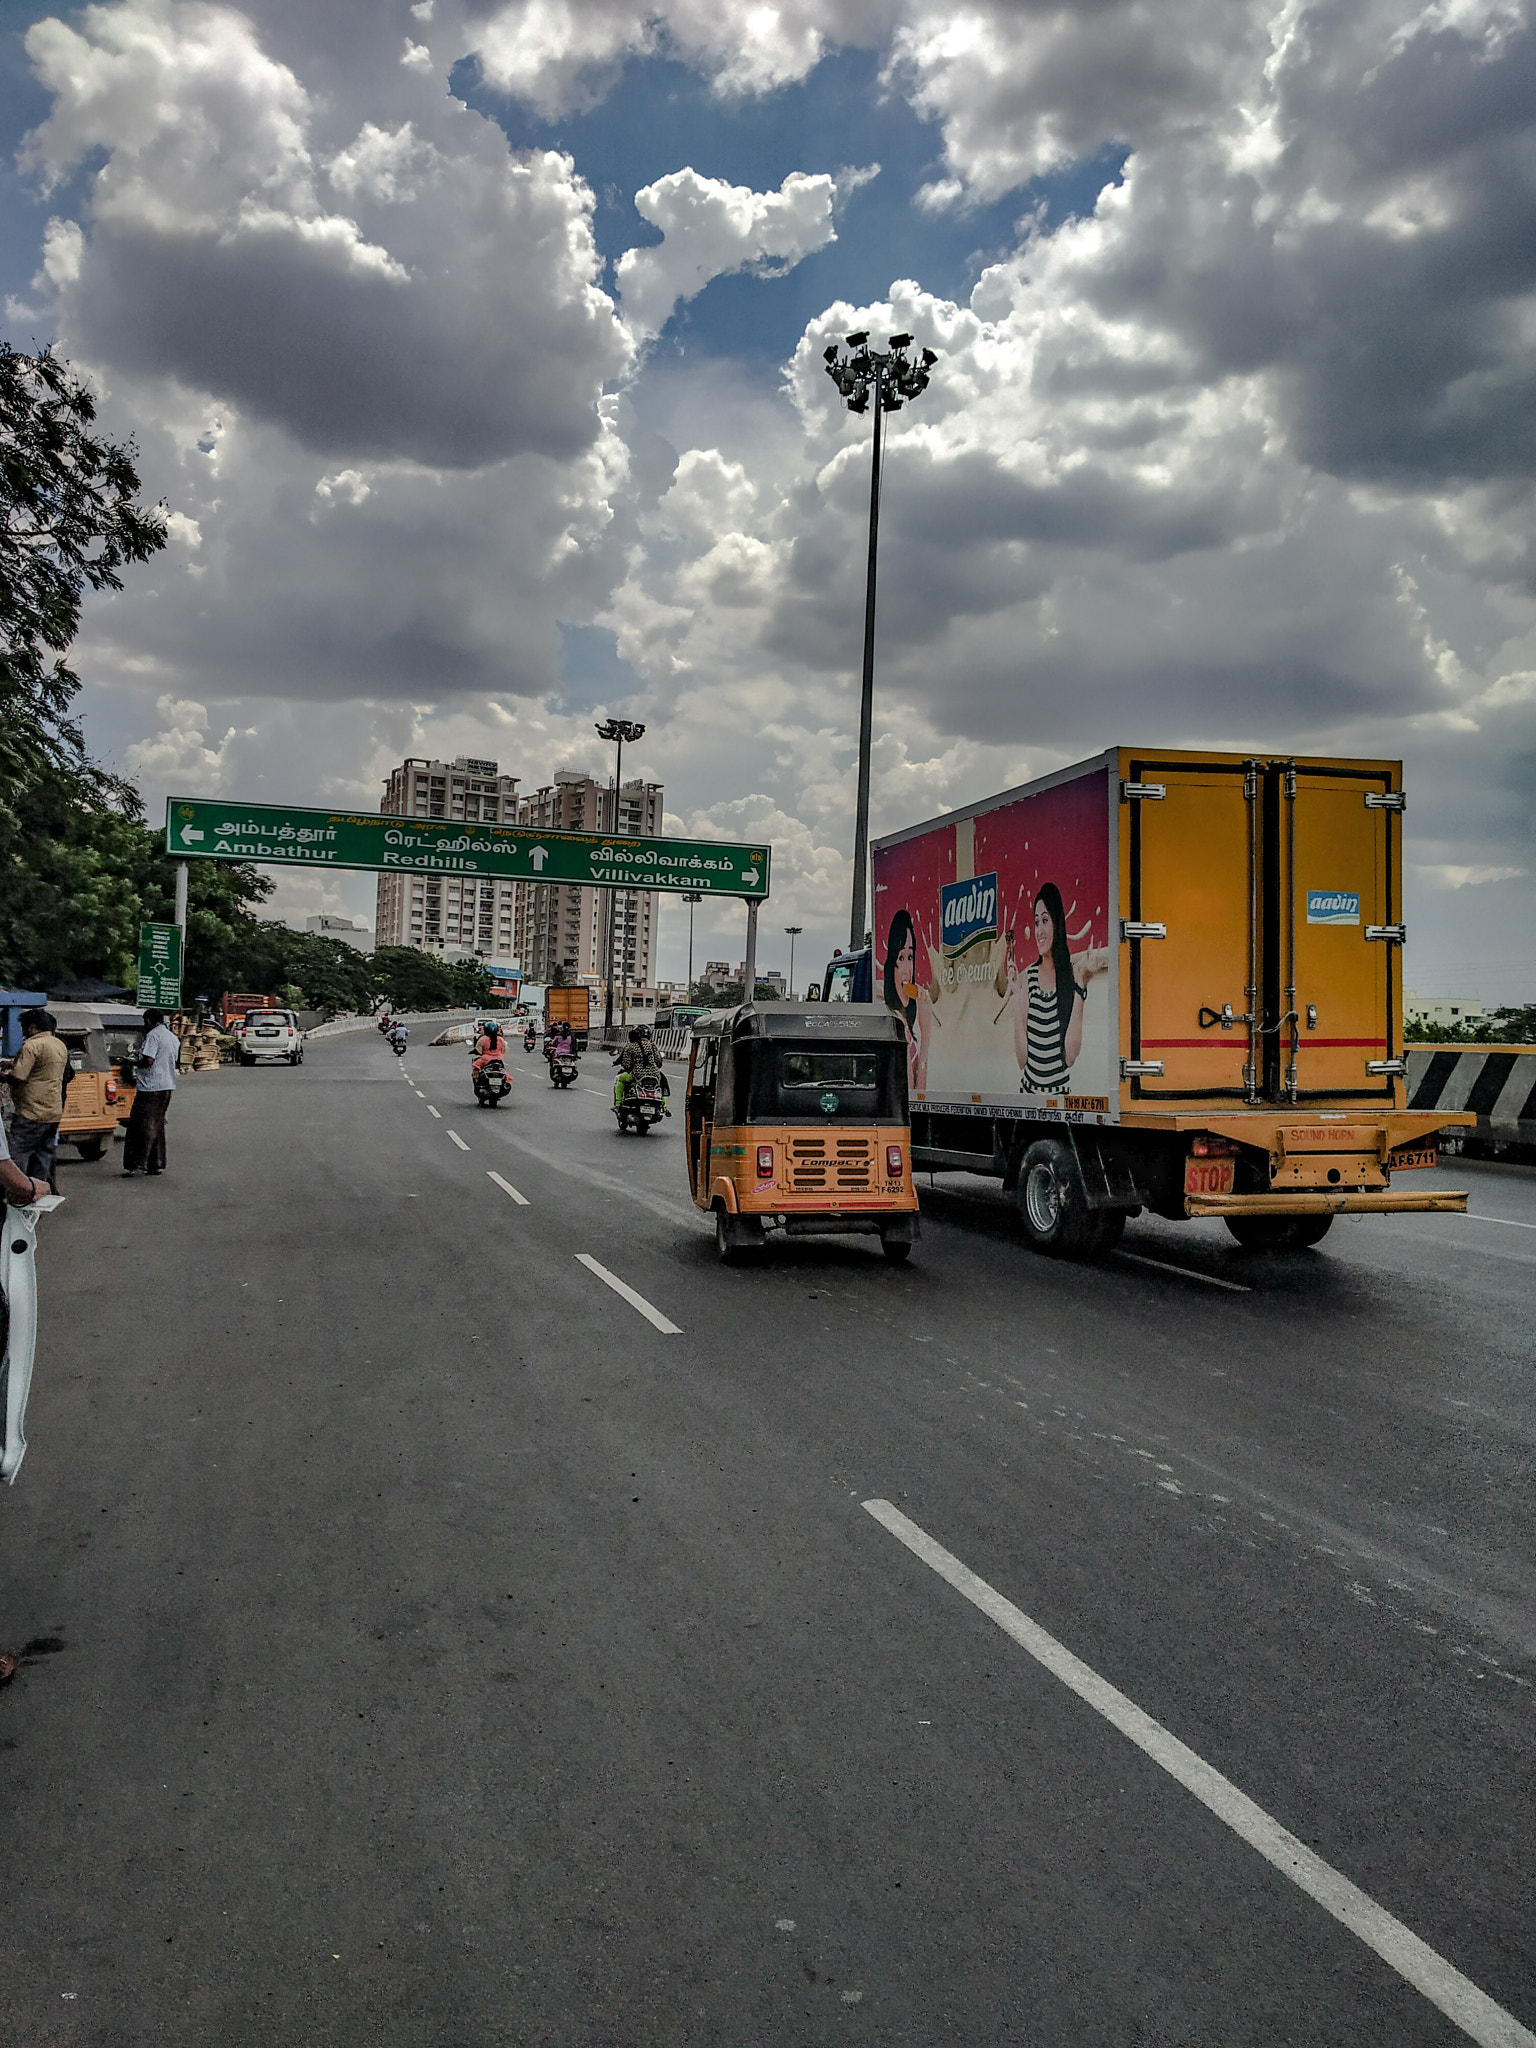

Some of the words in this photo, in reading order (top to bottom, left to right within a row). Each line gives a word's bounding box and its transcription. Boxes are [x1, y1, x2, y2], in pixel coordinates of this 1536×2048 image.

[214, 819, 338, 843] அம்பத்தூர்
[384, 829, 517, 854] ரெட்ஹில்ஸ்
[213, 839, 338, 860] Ambathur
[383, 851, 478, 870] Redhills
[589, 846, 734, 872] வில்லிவாக்கம்
[589, 866, 711, 888] Villivakkam
[944, 881, 995, 928] aavin
[1309, 894, 1358, 913] aavin
[1290, 1129, 1325, 1141] SOUND
[1328, 1129, 1355, 1141] HORN
[1187, 1165, 1233, 1193] STOP
